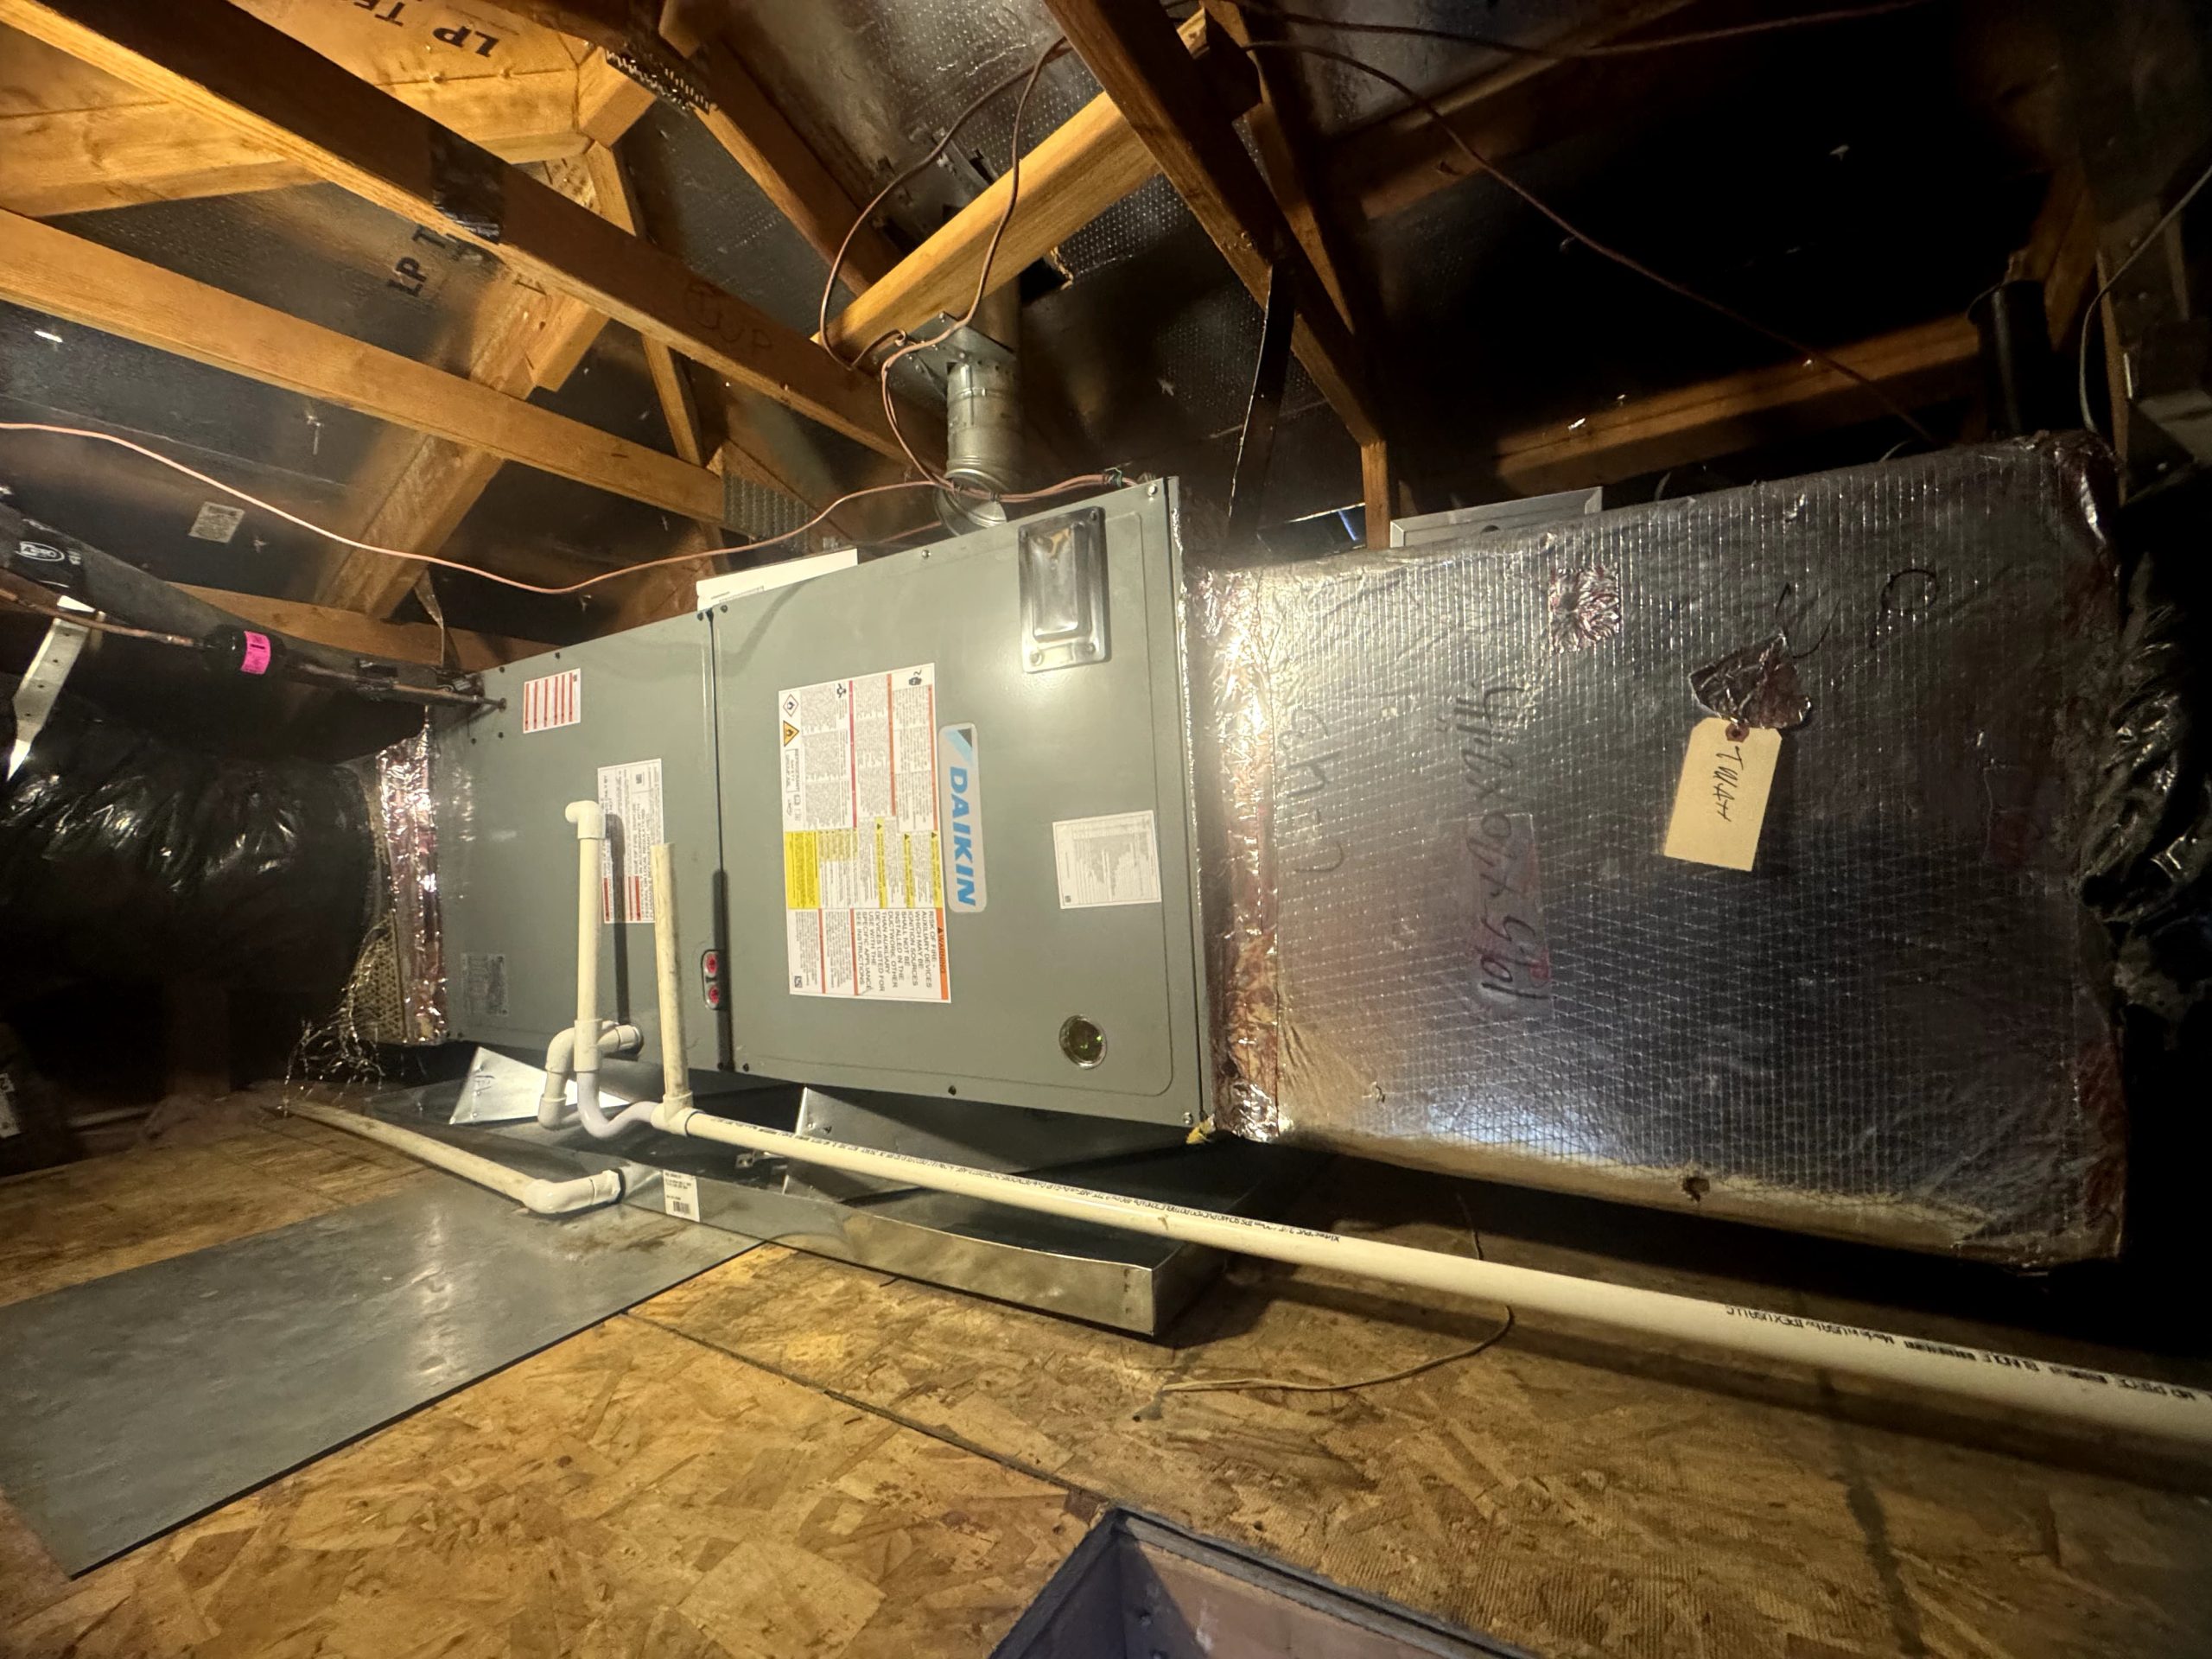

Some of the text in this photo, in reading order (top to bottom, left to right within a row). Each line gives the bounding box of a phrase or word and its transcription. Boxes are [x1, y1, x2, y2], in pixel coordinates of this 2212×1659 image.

[433, 26, 499, 57] LP
[387, 257, 427, 297] LP
[950, 766, 976, 906] DAIKIN
[930, 931, 935, 942] OF
[904, 956, 909, 966] BE
[918, 958, 923, 969] BE
